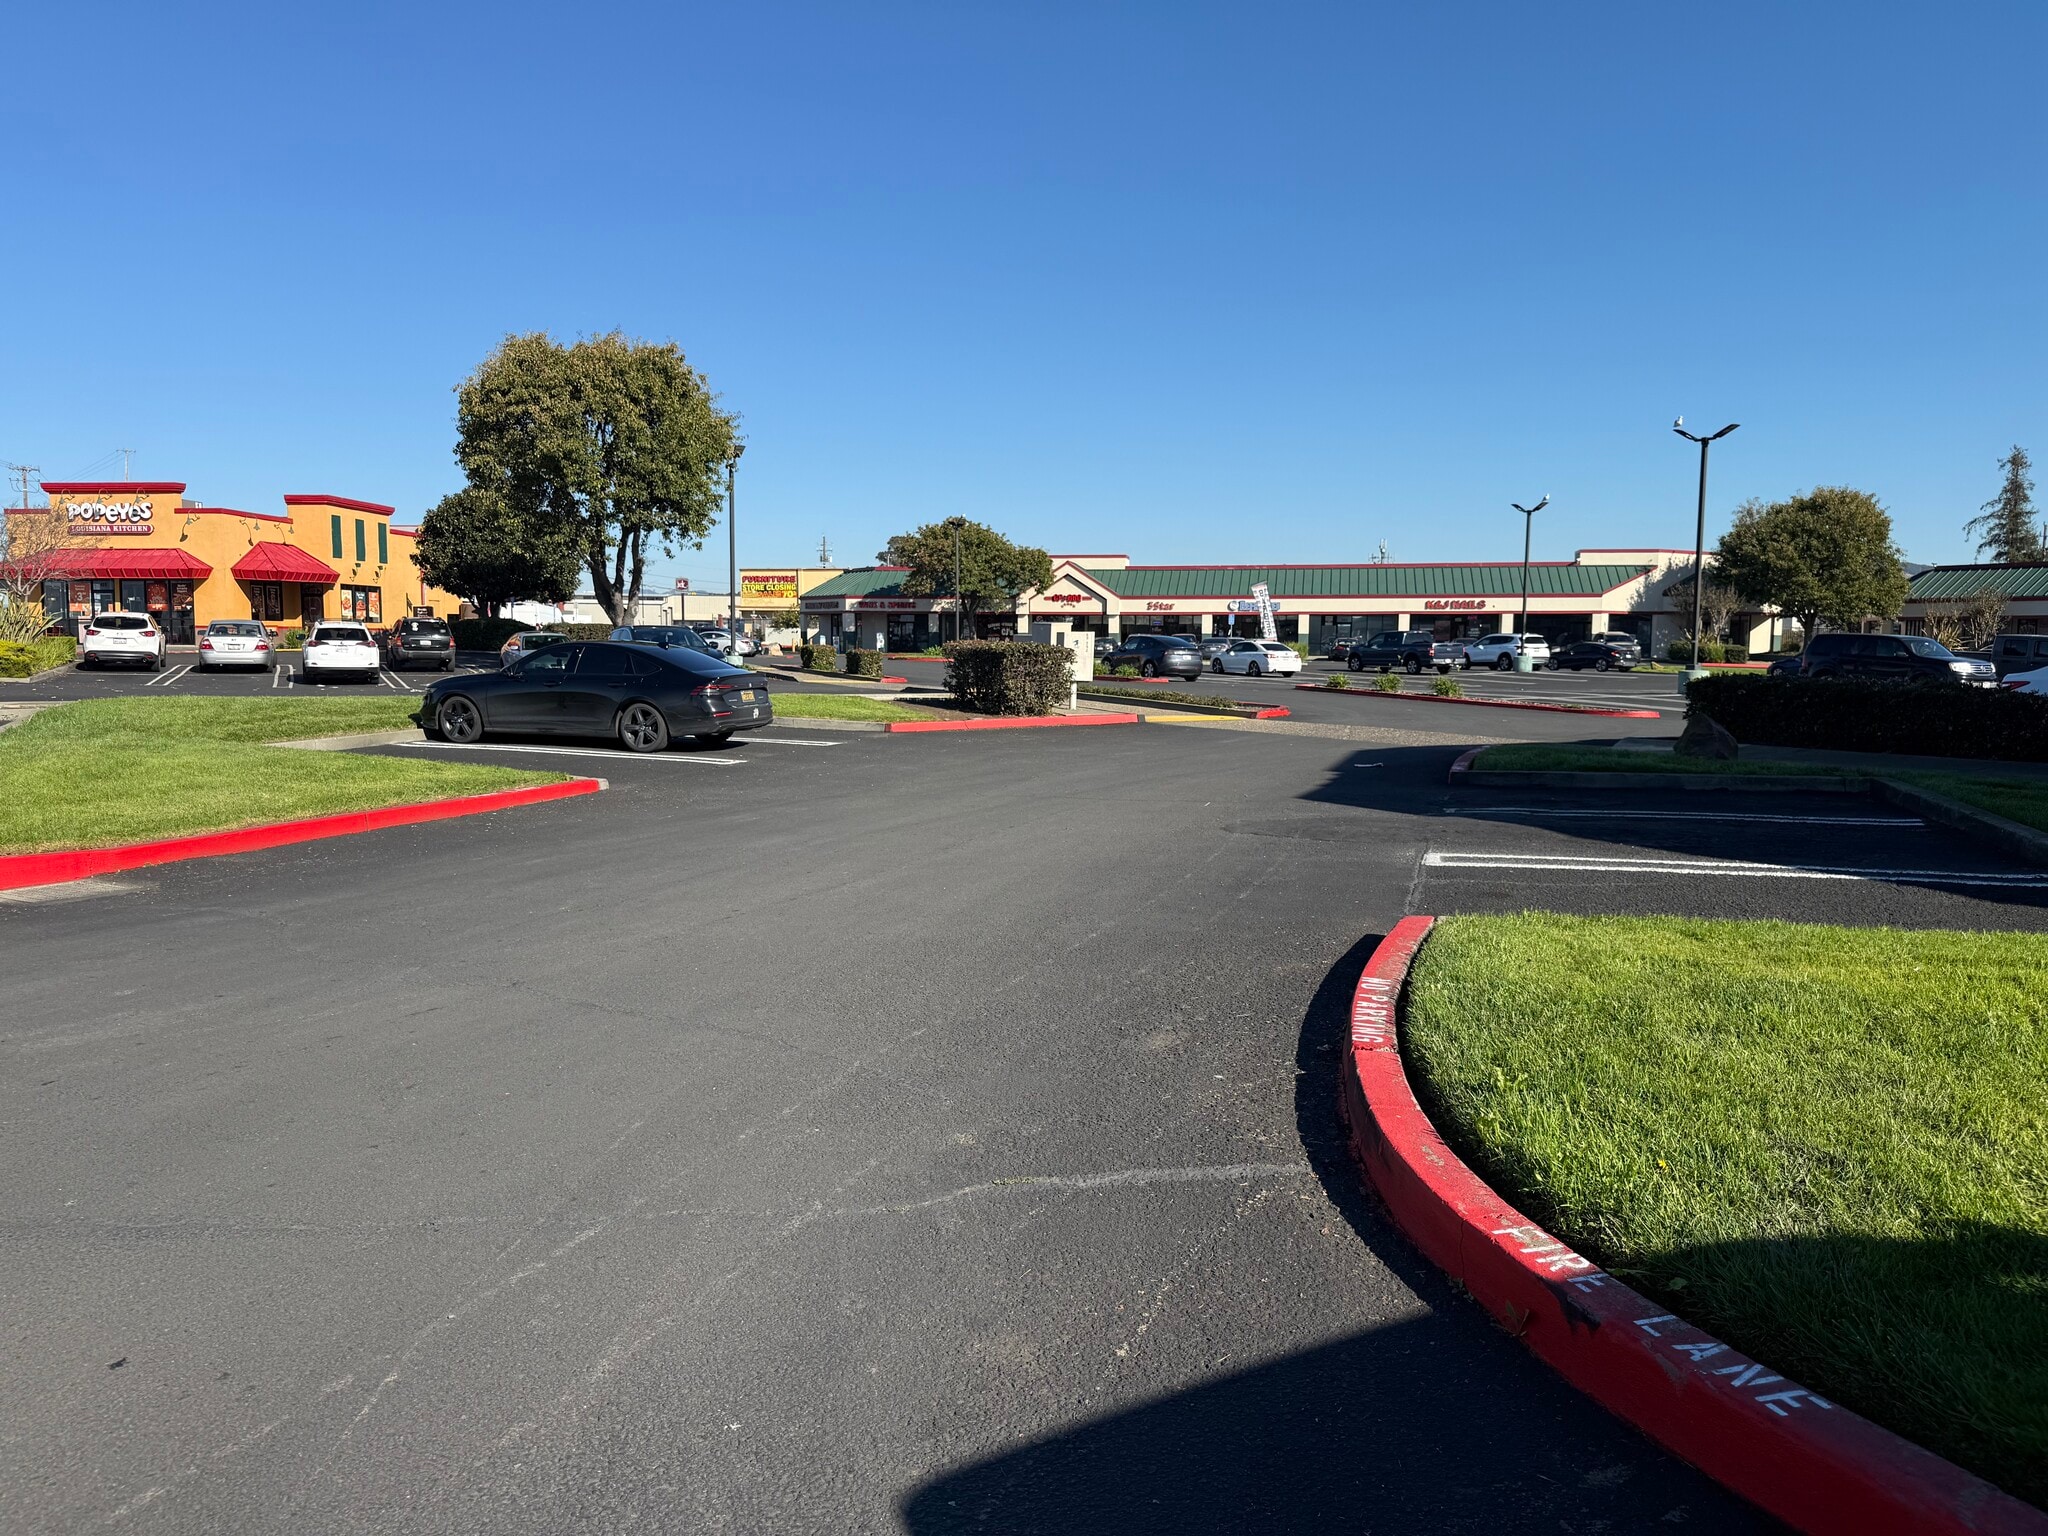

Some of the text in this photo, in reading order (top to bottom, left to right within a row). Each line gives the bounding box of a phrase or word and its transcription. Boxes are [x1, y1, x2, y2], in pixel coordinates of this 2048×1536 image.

[1450, 600, 1486, 610] NAILS
[1352, 976, 1392, 1043] NO PARKING
[1493, 1225, 1832, 1416] FIRE LANE
